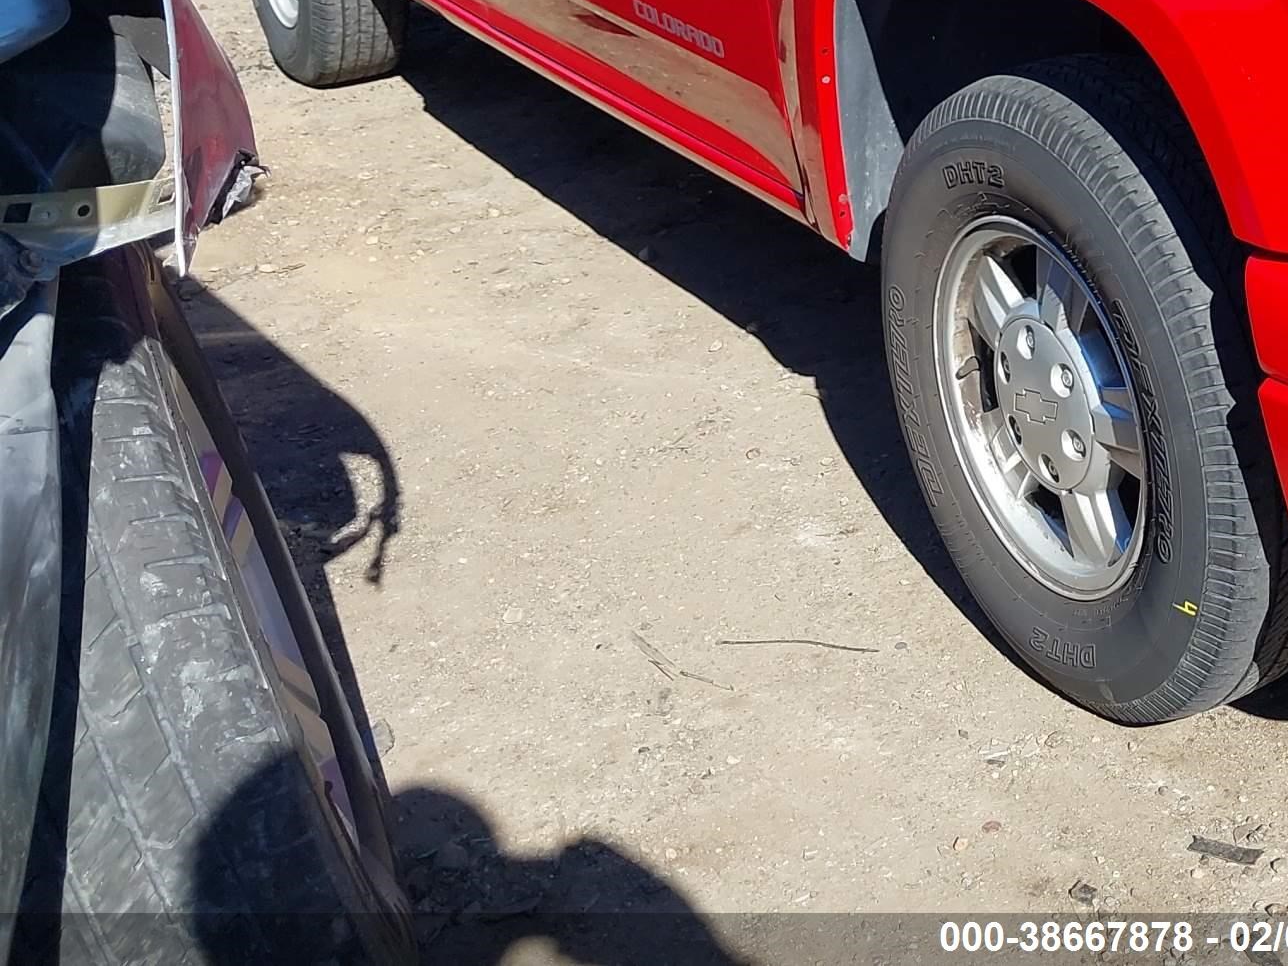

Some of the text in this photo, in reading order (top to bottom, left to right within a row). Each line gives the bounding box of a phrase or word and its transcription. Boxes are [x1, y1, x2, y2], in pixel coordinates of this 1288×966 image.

[942, 160, 1005, 190] DHT2
[888, 284, 944, 508] DEXTERO
[1028, 625, 1097, 669] DHT2
